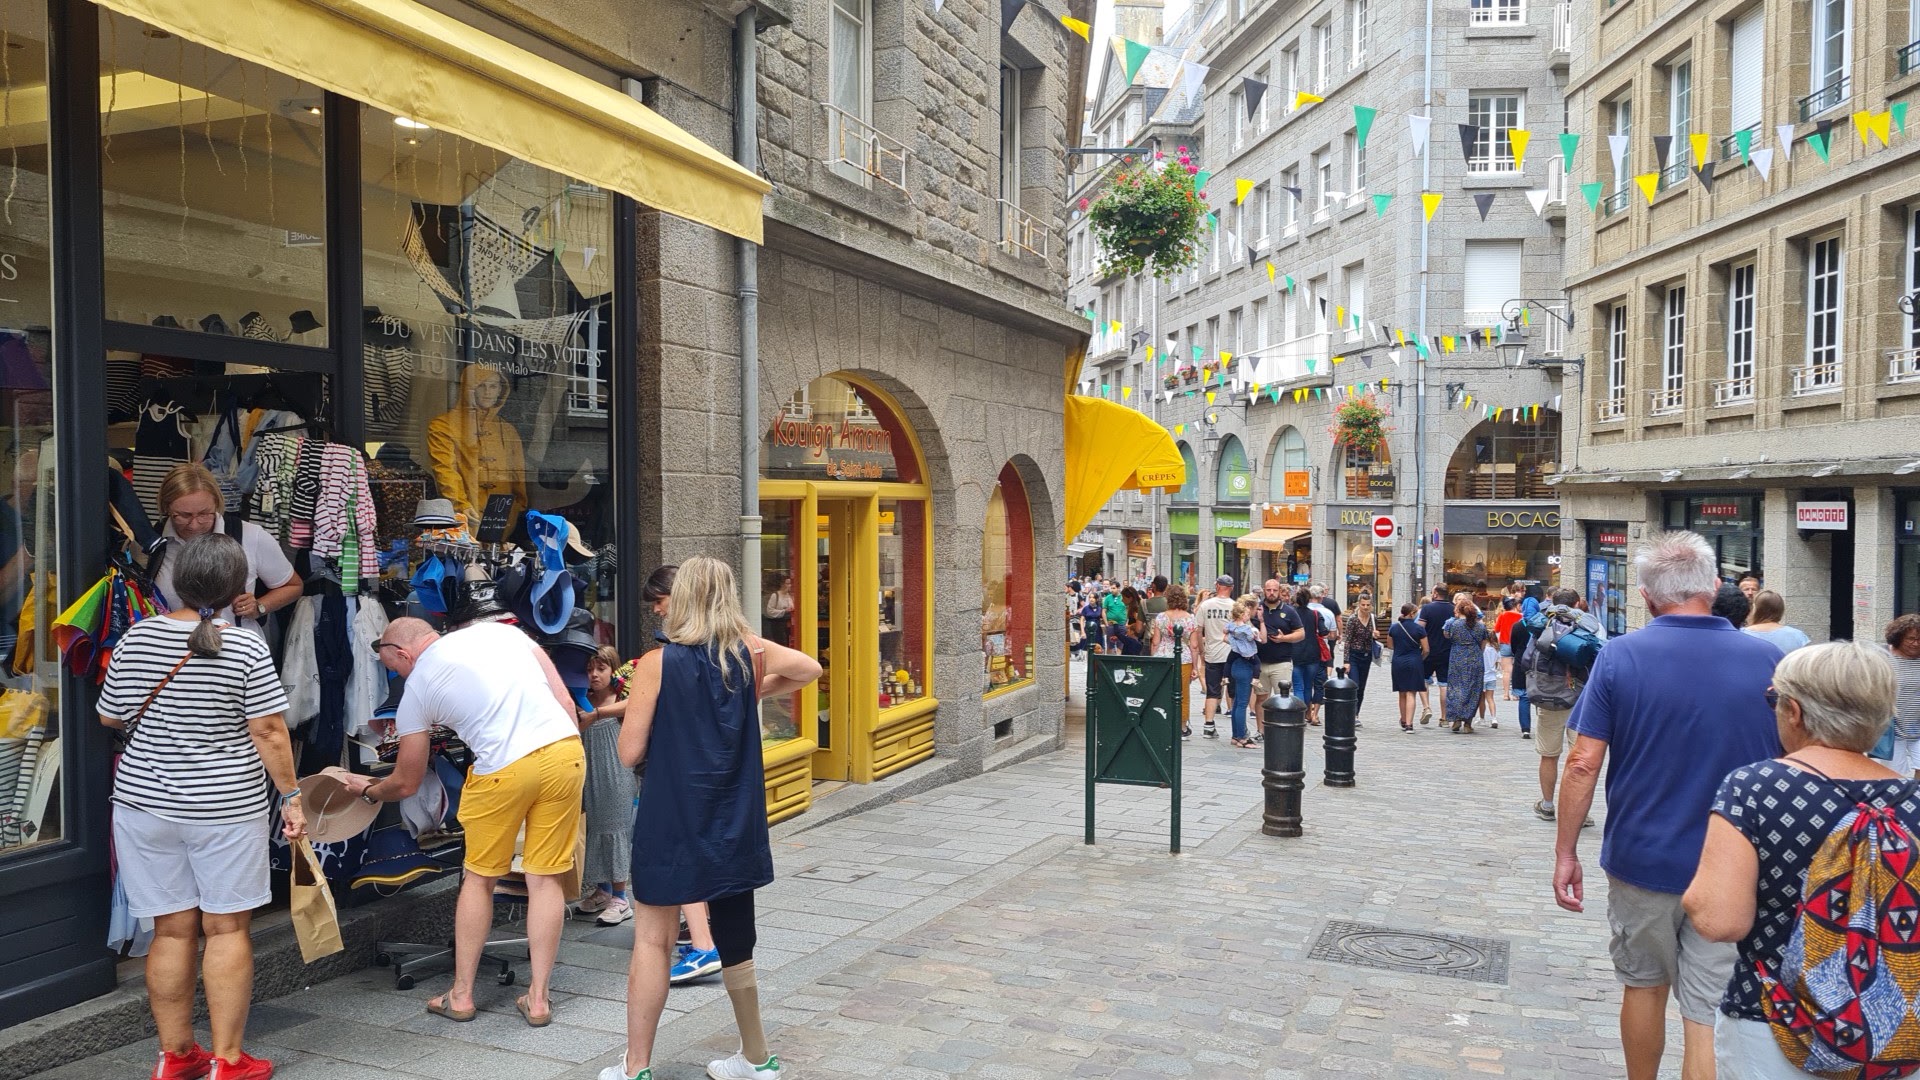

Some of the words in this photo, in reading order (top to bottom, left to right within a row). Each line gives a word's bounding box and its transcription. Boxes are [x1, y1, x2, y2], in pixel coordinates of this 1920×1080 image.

[1, 253, 18, 281] S
[382, 321, 411, 339] DU
[417, 322, 466, 348] VENT
[471, 330, 515, 356] DANS
[519, 337, 548, 360] LES
[549, 343, 602, 368] VOILES
[477, 357, 529, 377] Saint-Malo
[774, 409, 834, 458] Kouign
[840, 419, 892, 455] Amann
[826, 458, 837, 477] de
[840, 459, 883, 479] Saint-Malo
[1142, 473, 1176, 482] CRÊPES
[1702, 506, 1738, 515] LAMOTTE
[1799, 509, 1845, 521] LAMOTTE
[1207, 609, 1233, 619] STAF
